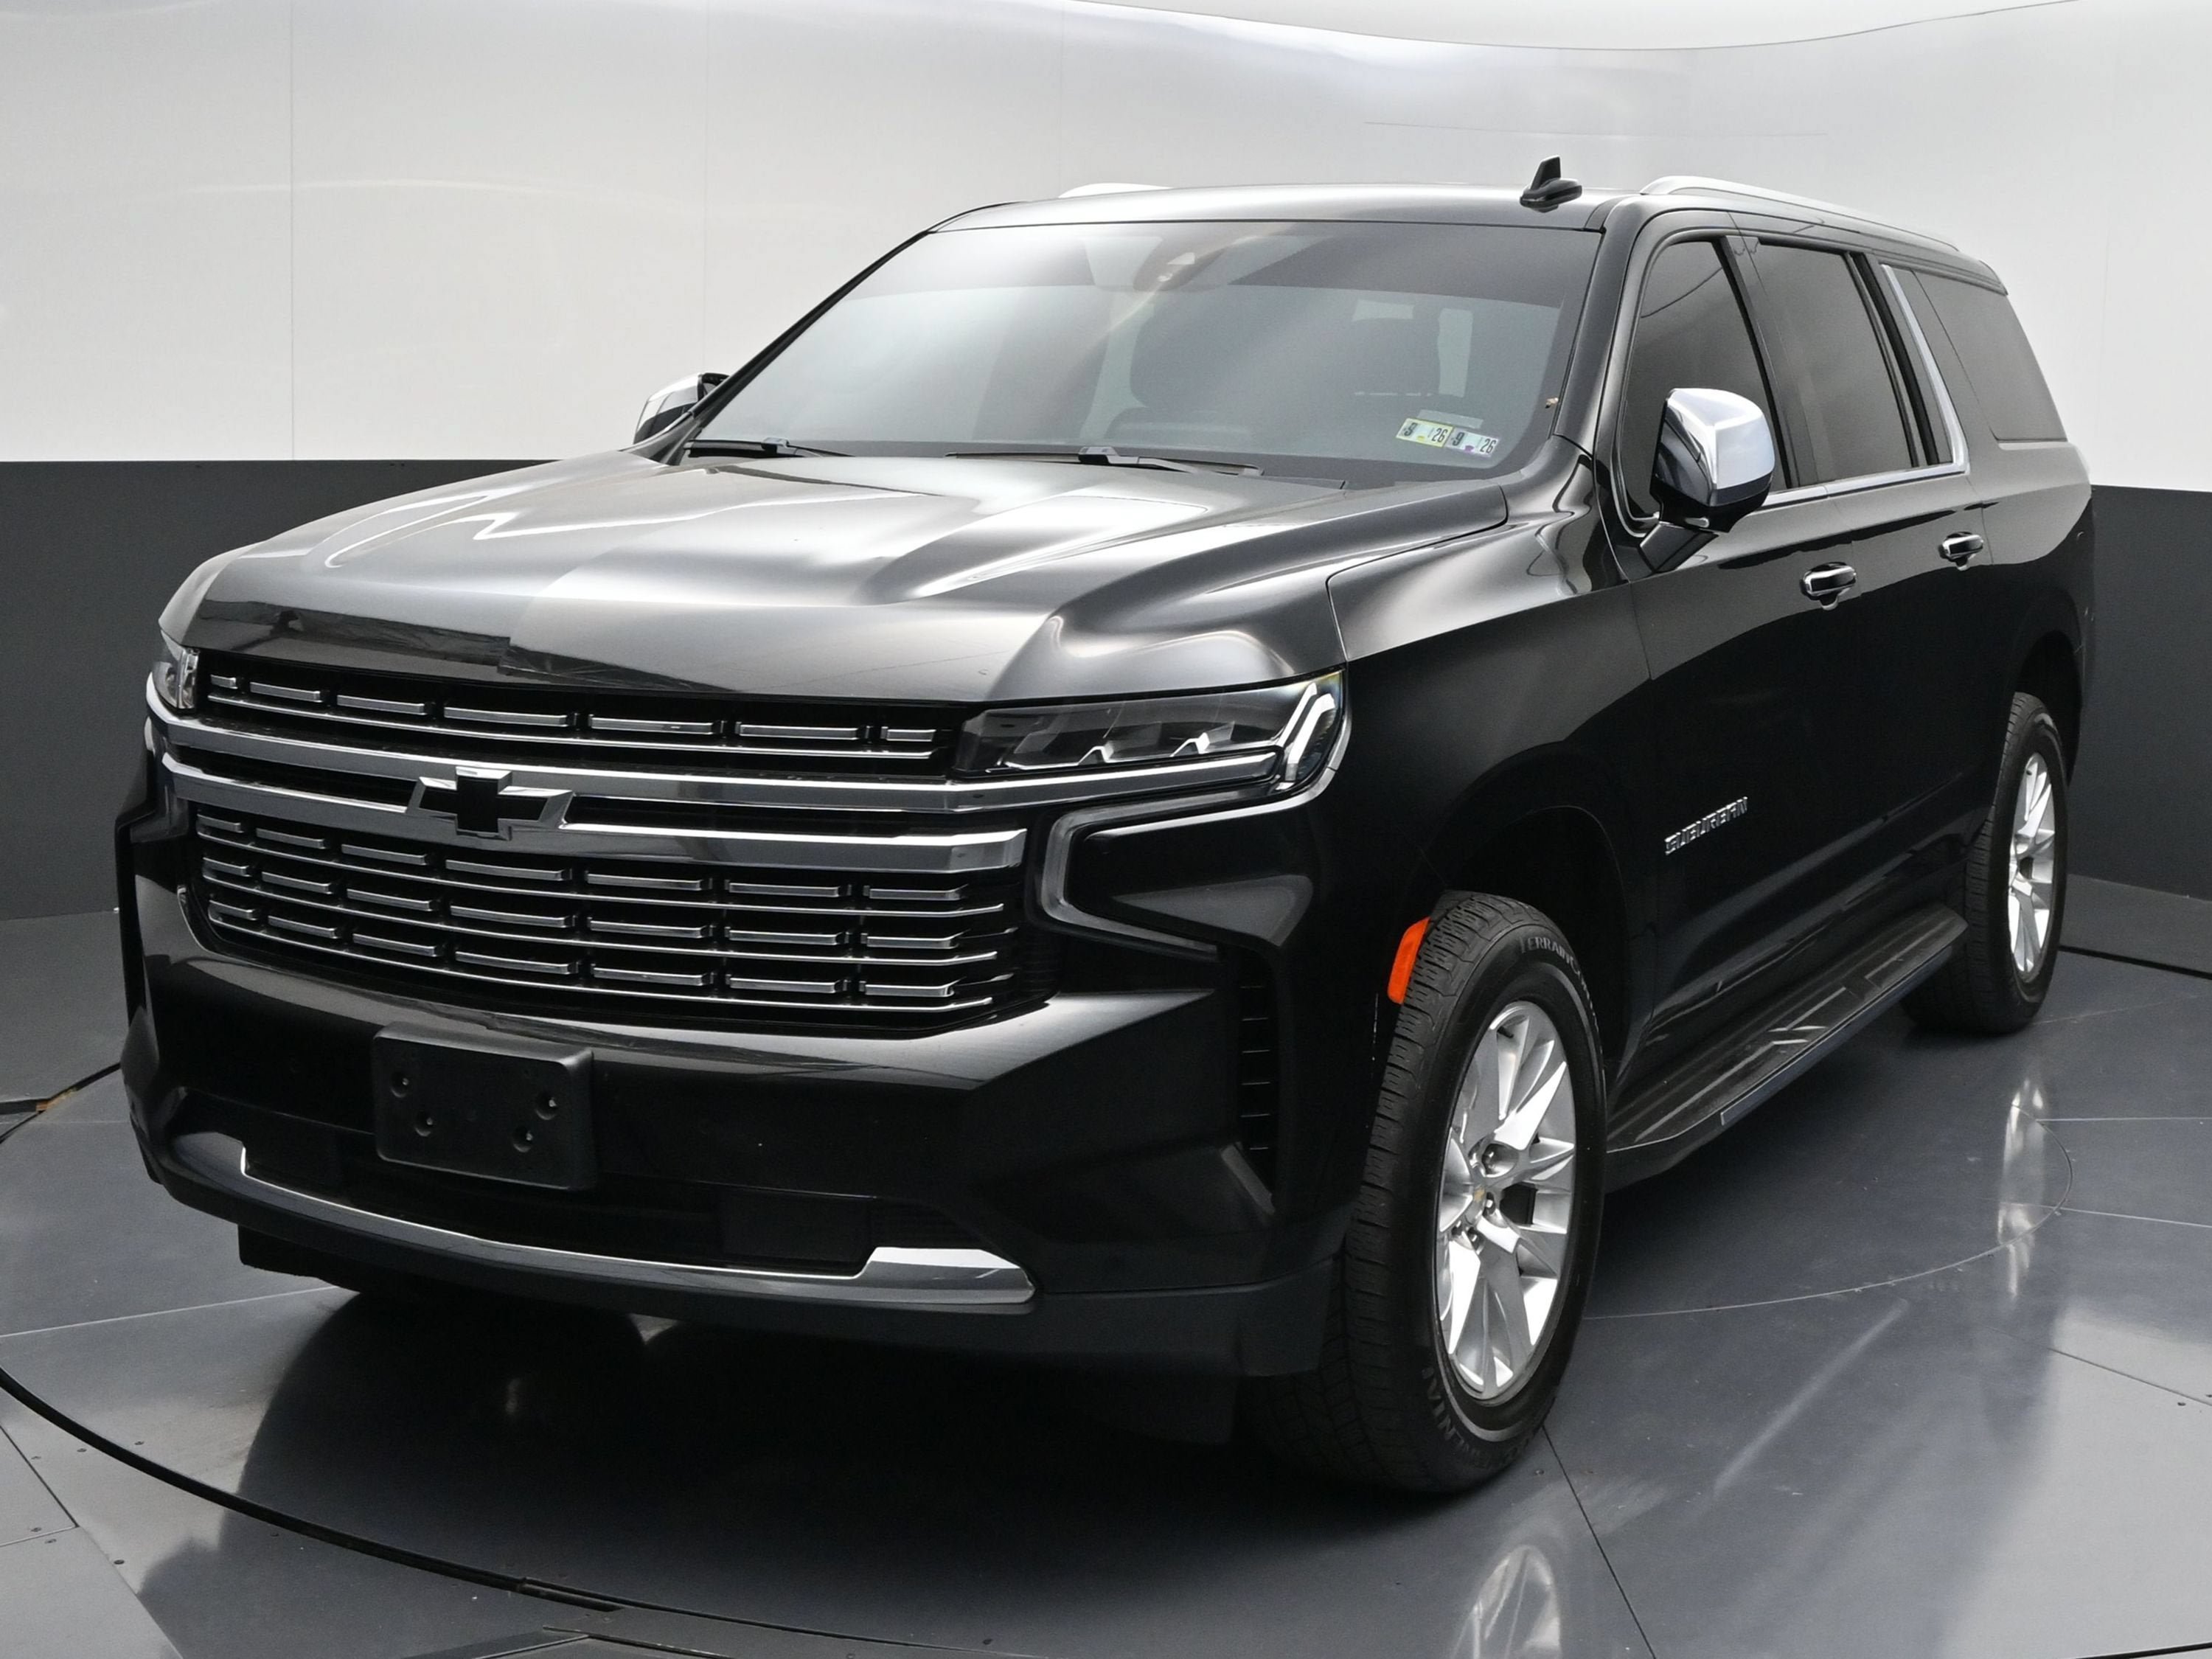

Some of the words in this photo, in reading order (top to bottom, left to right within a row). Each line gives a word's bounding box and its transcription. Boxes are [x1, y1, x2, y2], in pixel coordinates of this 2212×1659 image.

[1431, 428, 1448, 443] 26
[1451, 431, 1465, 446] 9
[1479, 438, 1497, 453] 26
[1664, 796, 1748, 856] SUBURBAN
